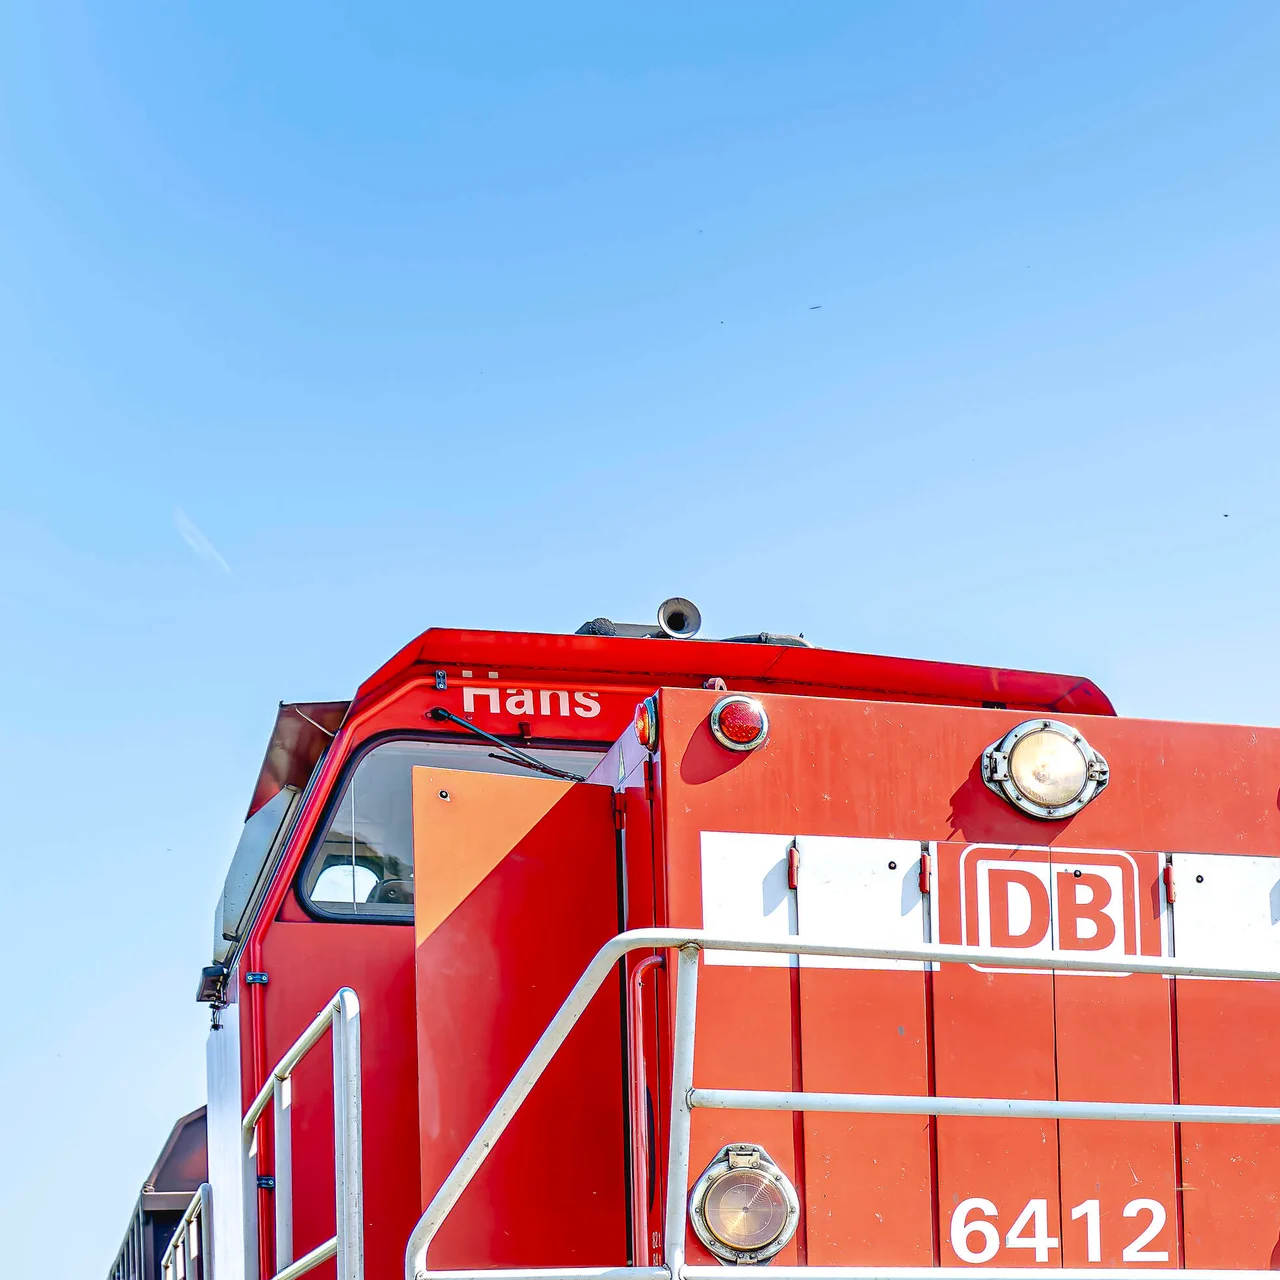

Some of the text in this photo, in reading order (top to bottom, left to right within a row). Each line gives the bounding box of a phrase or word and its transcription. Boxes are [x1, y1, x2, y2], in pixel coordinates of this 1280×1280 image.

[462, 670, 602, 718] Hans
[987, 867, 1117, 951] DB
[950, 1197, 1170, 1264] 6412
